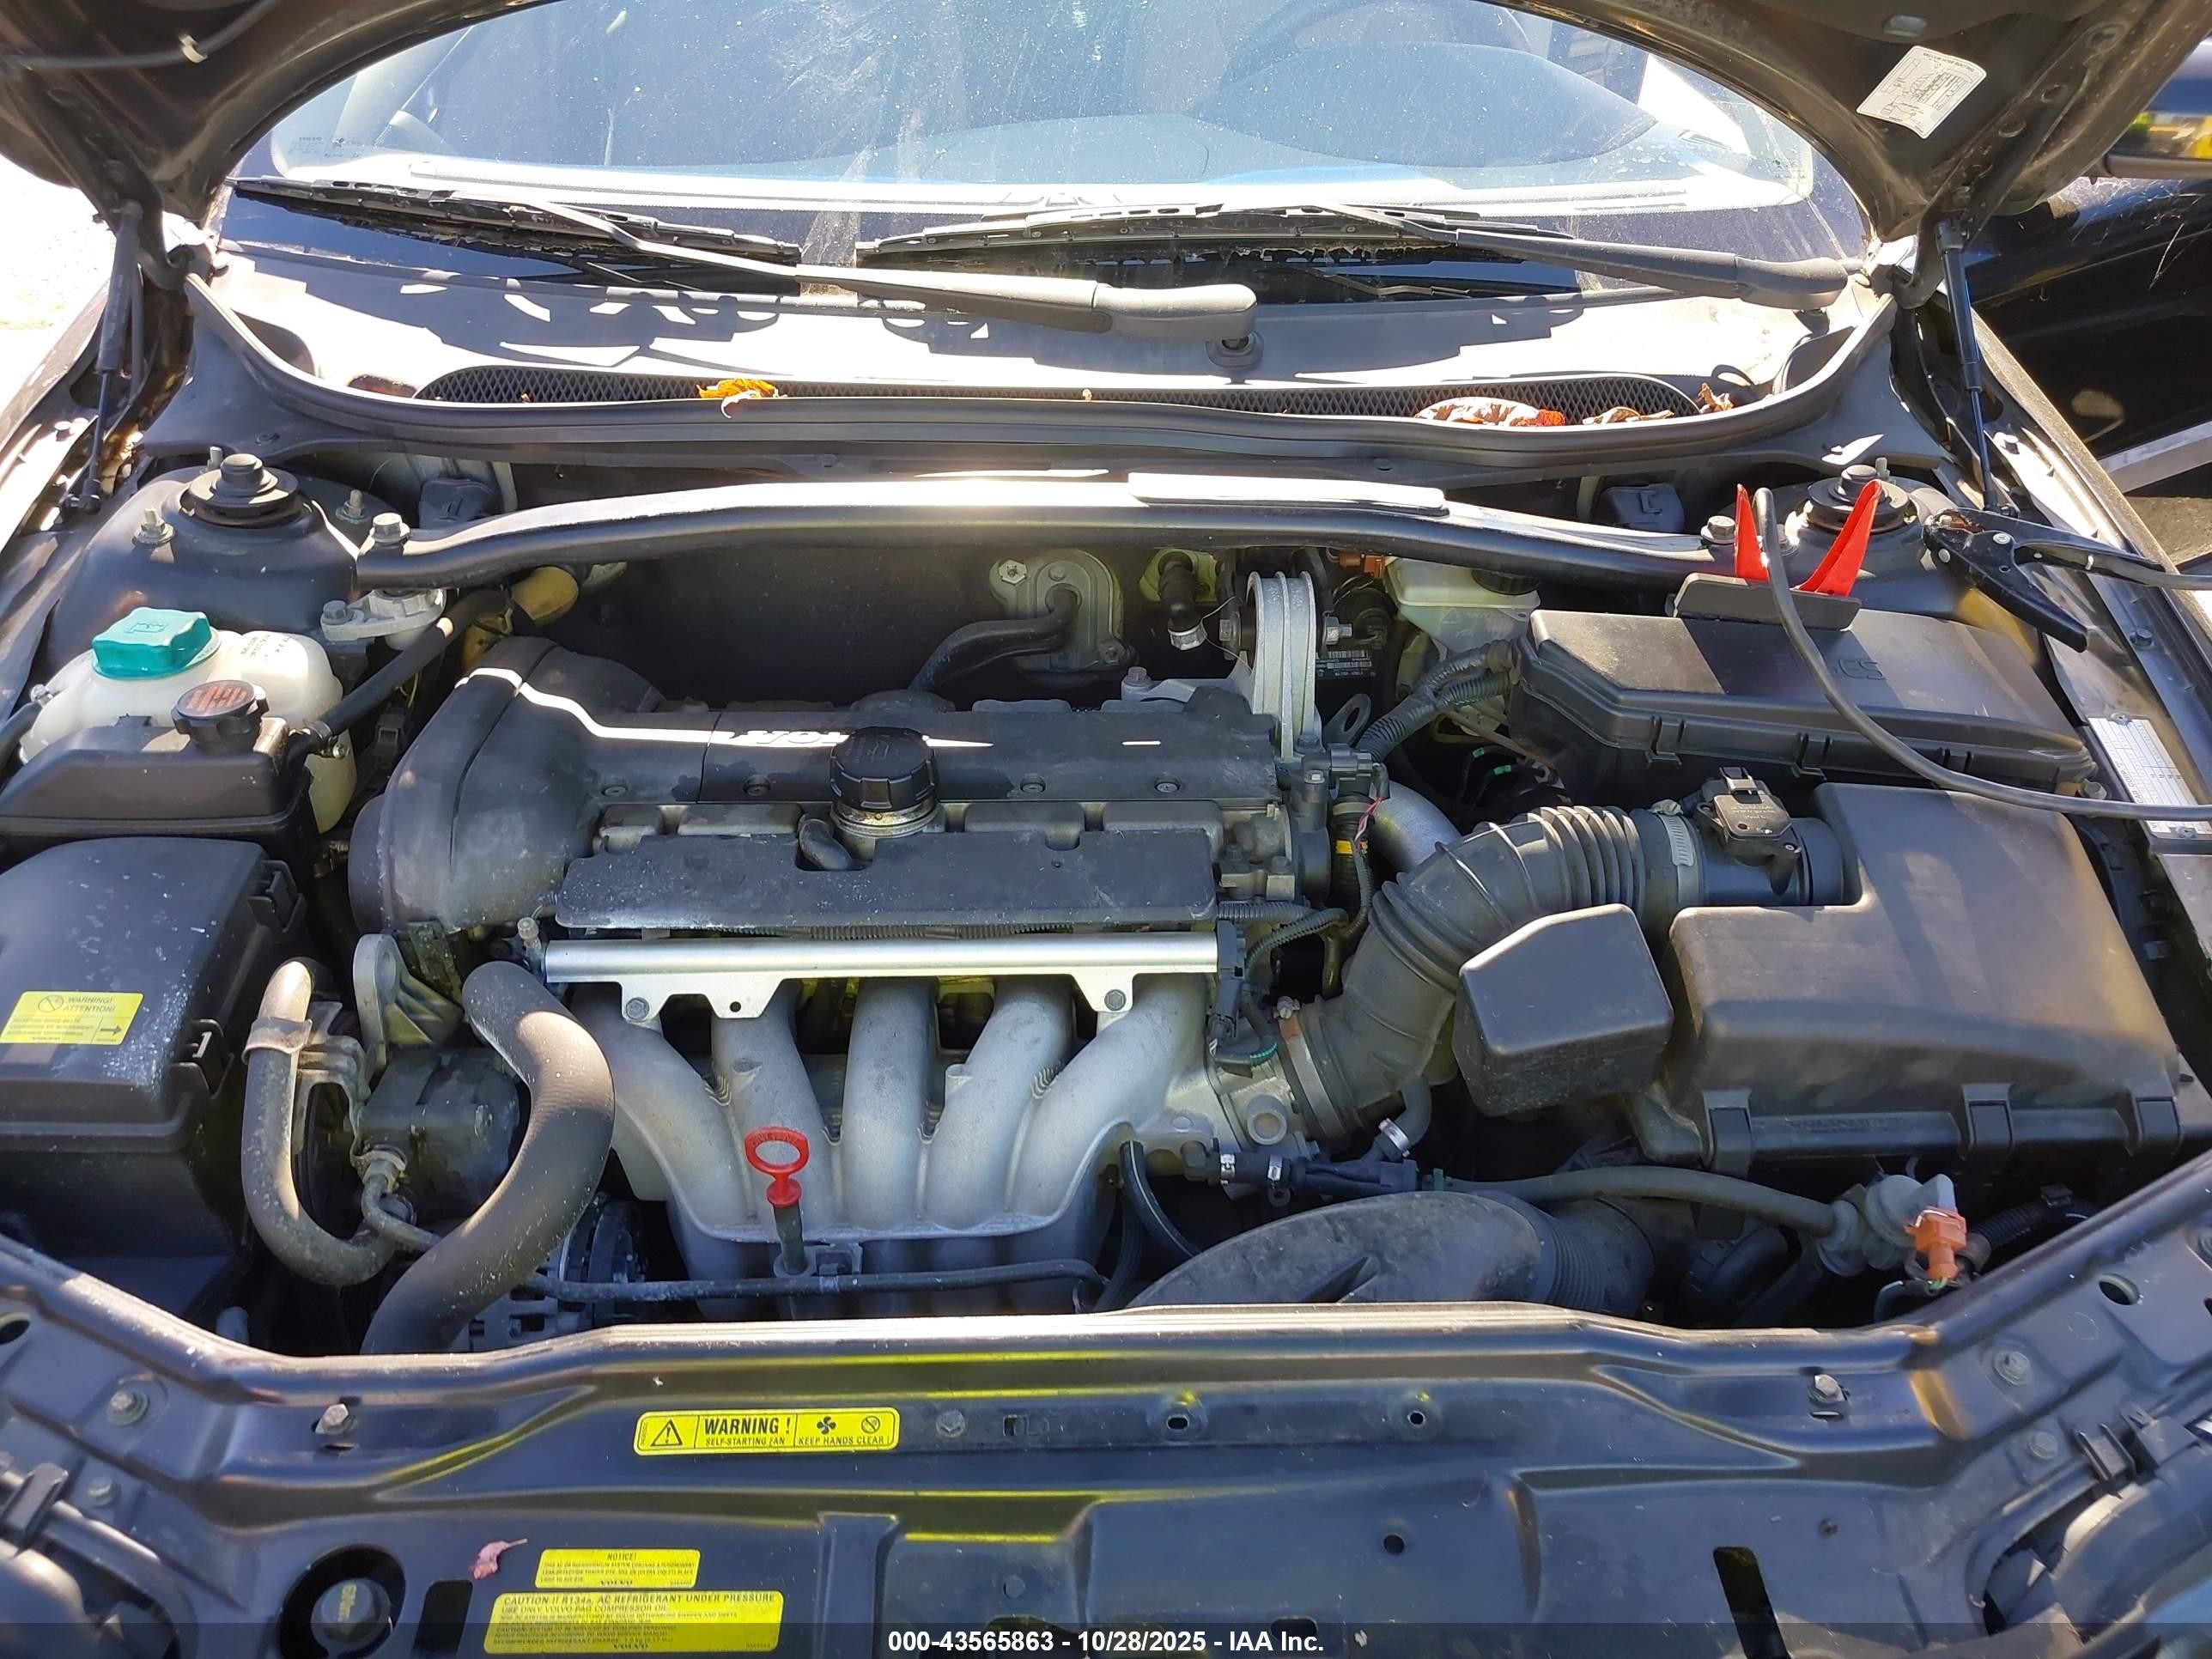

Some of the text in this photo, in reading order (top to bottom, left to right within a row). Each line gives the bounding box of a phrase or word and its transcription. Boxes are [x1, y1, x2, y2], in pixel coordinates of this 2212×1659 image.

[704, 1417, 792, 1435] WARNING !
[705, 1437, 785, 1446] SELF-STARTING FAN
[799, 1436, 821, 1445] KEEP
[823, 1435, 854, 1445] HANDS
[856, 1435, 884, 1444] CLEAR
[606, 1552, 637, 1561] NOTICE!
[503, 1596, 548, 1606] CAUTION
[597, 1595, 611, 1604] AC
[613, 1594, 683, 1604] REFRIGERANT
[685, 1593, 721, 1603] UNDER
[723, 1593, 775, 1602] PRESSURE
[594, 1604, 652, 1613] COMPRESSOR
